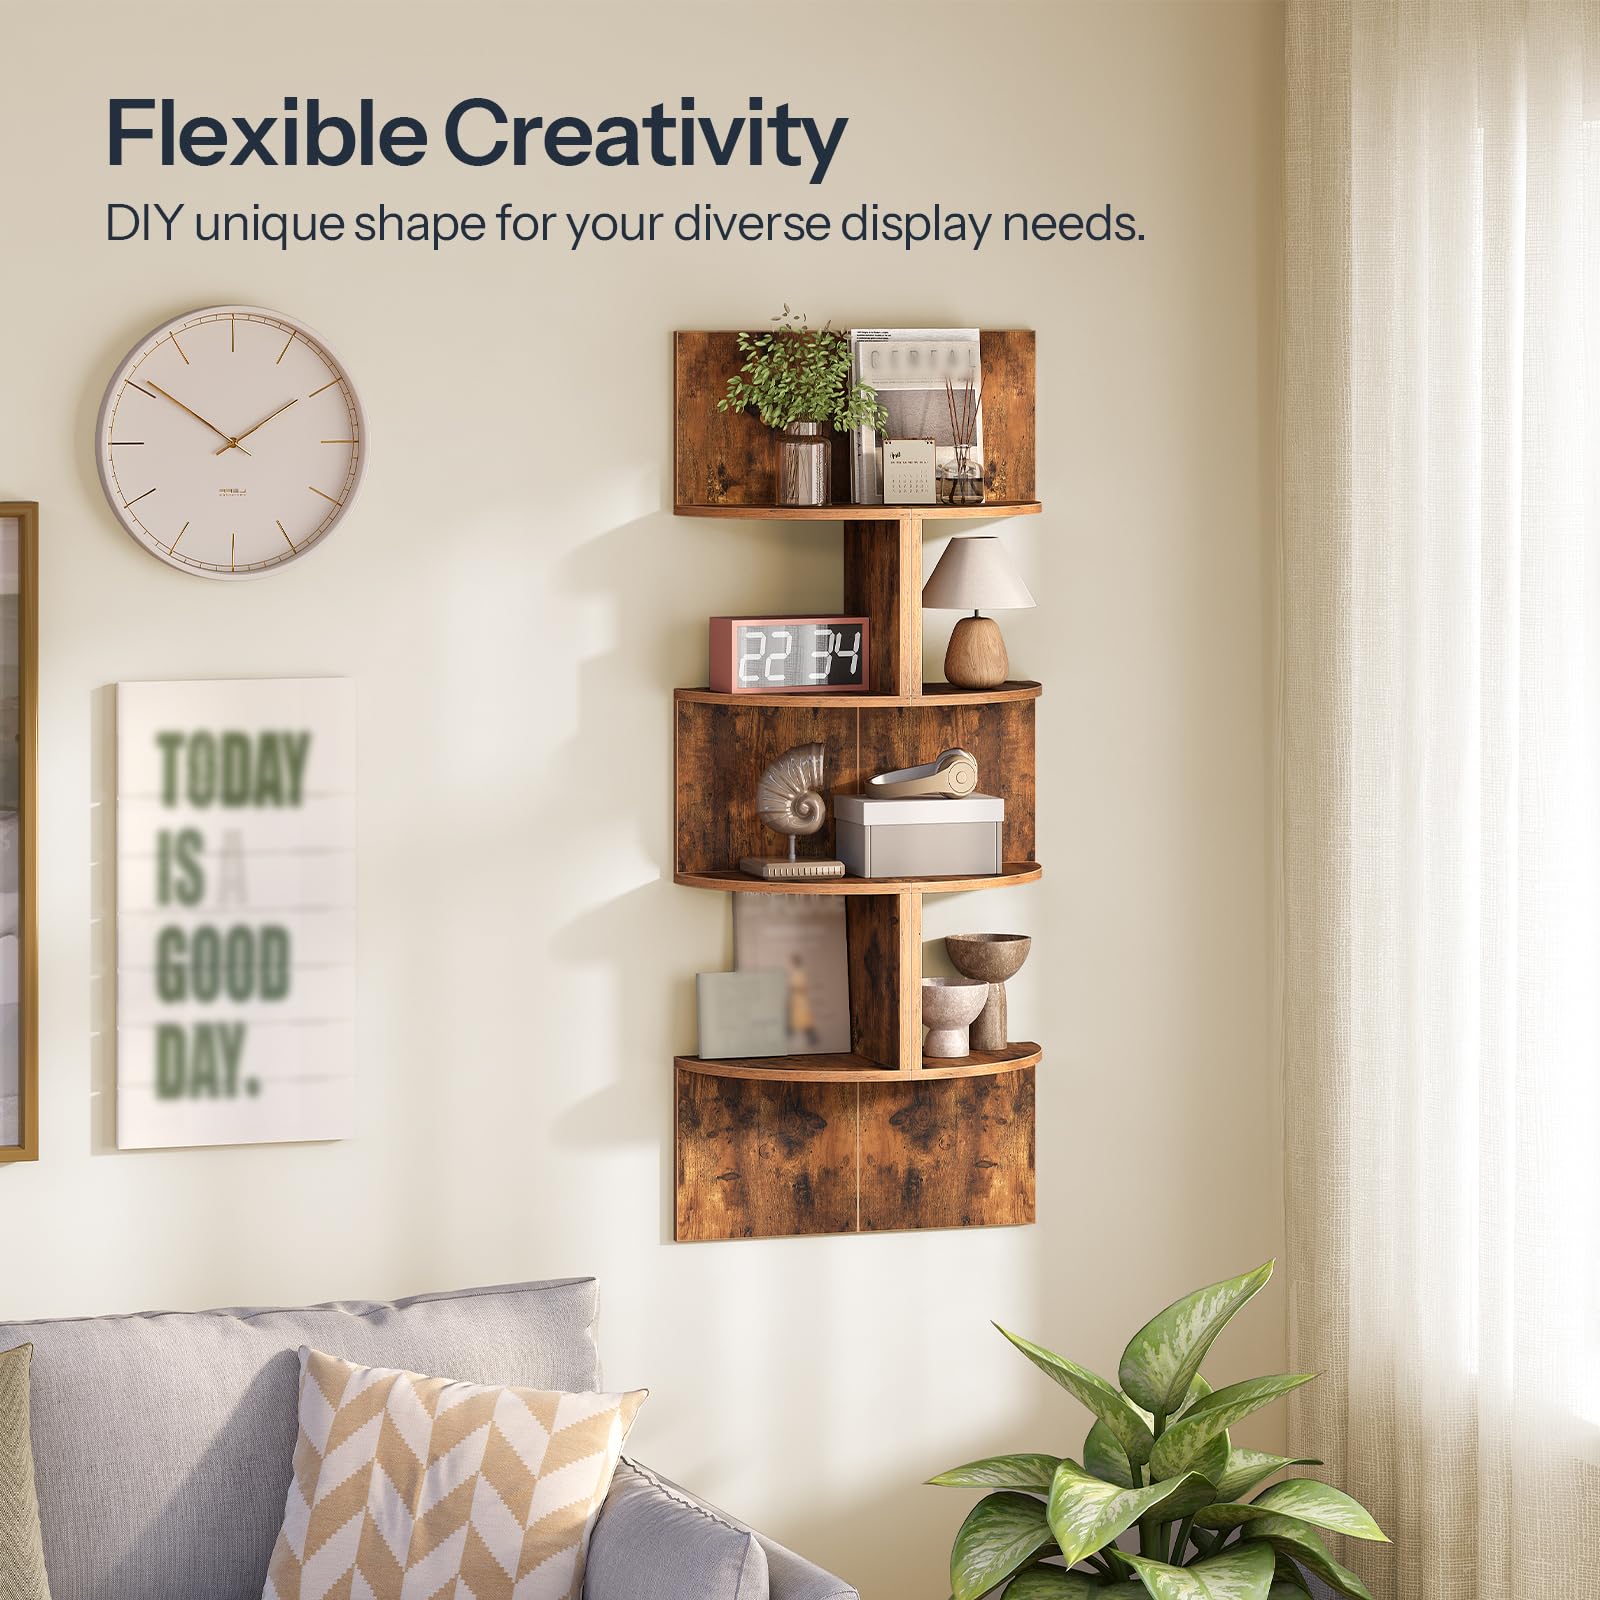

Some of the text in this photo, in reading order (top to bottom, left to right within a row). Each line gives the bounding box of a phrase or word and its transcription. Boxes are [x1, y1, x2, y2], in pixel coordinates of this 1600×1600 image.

[739, 629, 861, 681] 22 34
[156, 730, 311, 807] TODAY
[156, 828, 247, 907] IS A
[155, 924, 291, 1003] GOOD
[155, 1021, 261, 1100] DAY.
